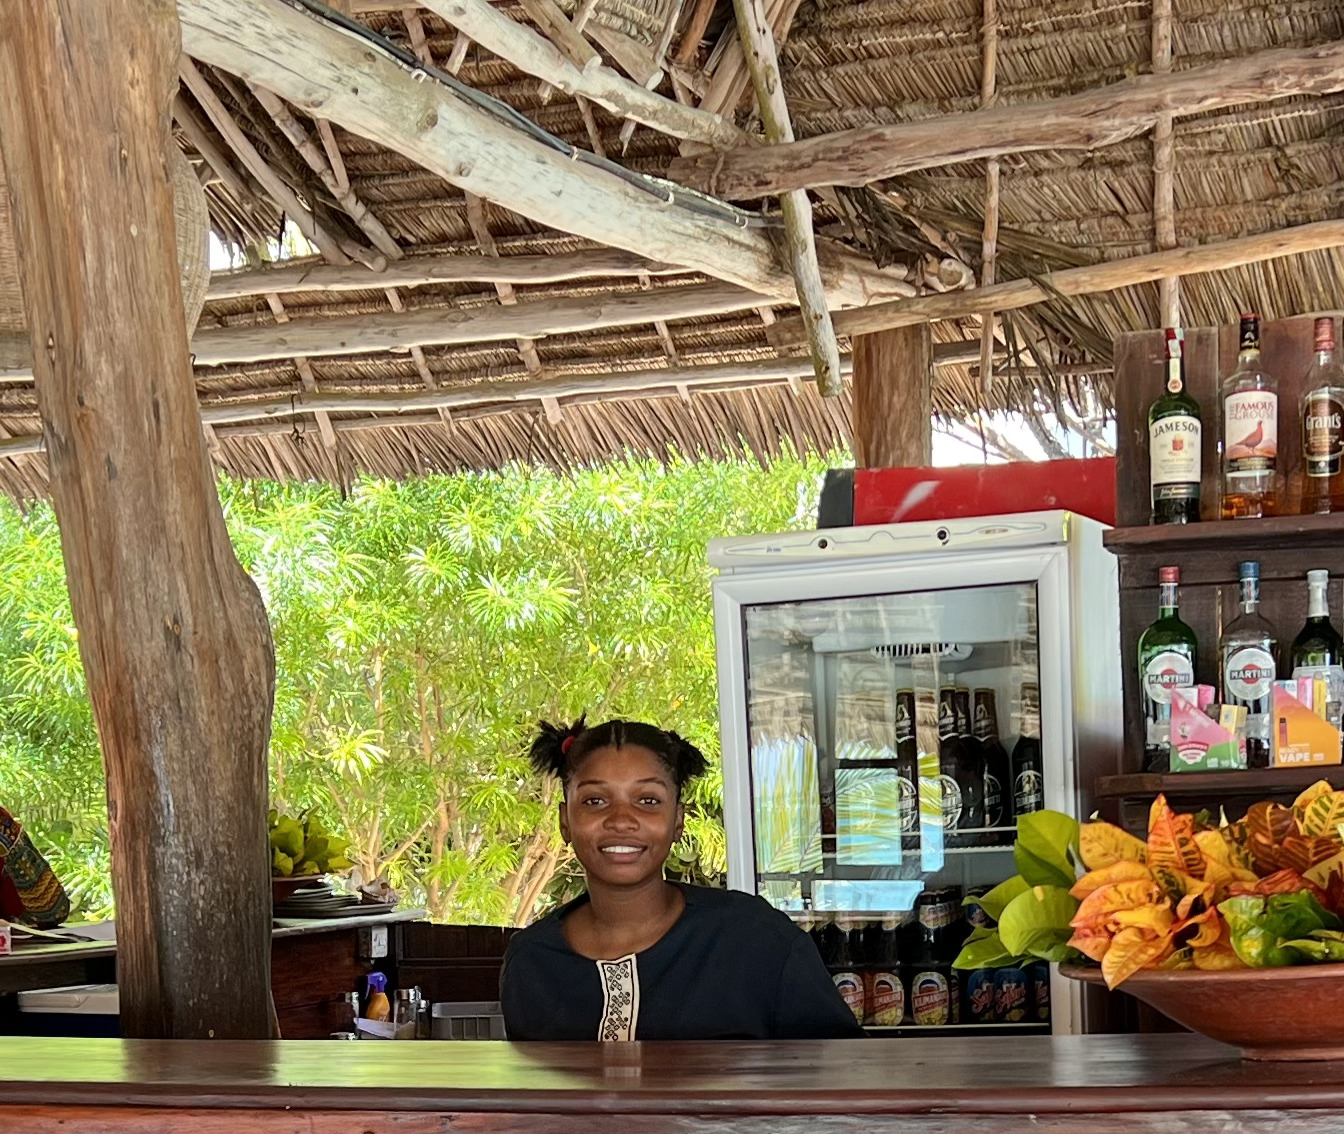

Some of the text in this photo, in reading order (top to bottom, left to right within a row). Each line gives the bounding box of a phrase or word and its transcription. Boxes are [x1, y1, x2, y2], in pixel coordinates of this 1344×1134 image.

[1235, 401, 1274, 412] FAMOUS
[1235, 410, 1274, 421] GROUSE
[1306, 412, 1341, 431] Grant's
[1153, 421, 1200, 438] JAMESON
[1149, 674, 1189, 684] MARTINI
[1230, 670, 1272, 680] MARTINI
[1279, 752, 1311, 763] VAPE
